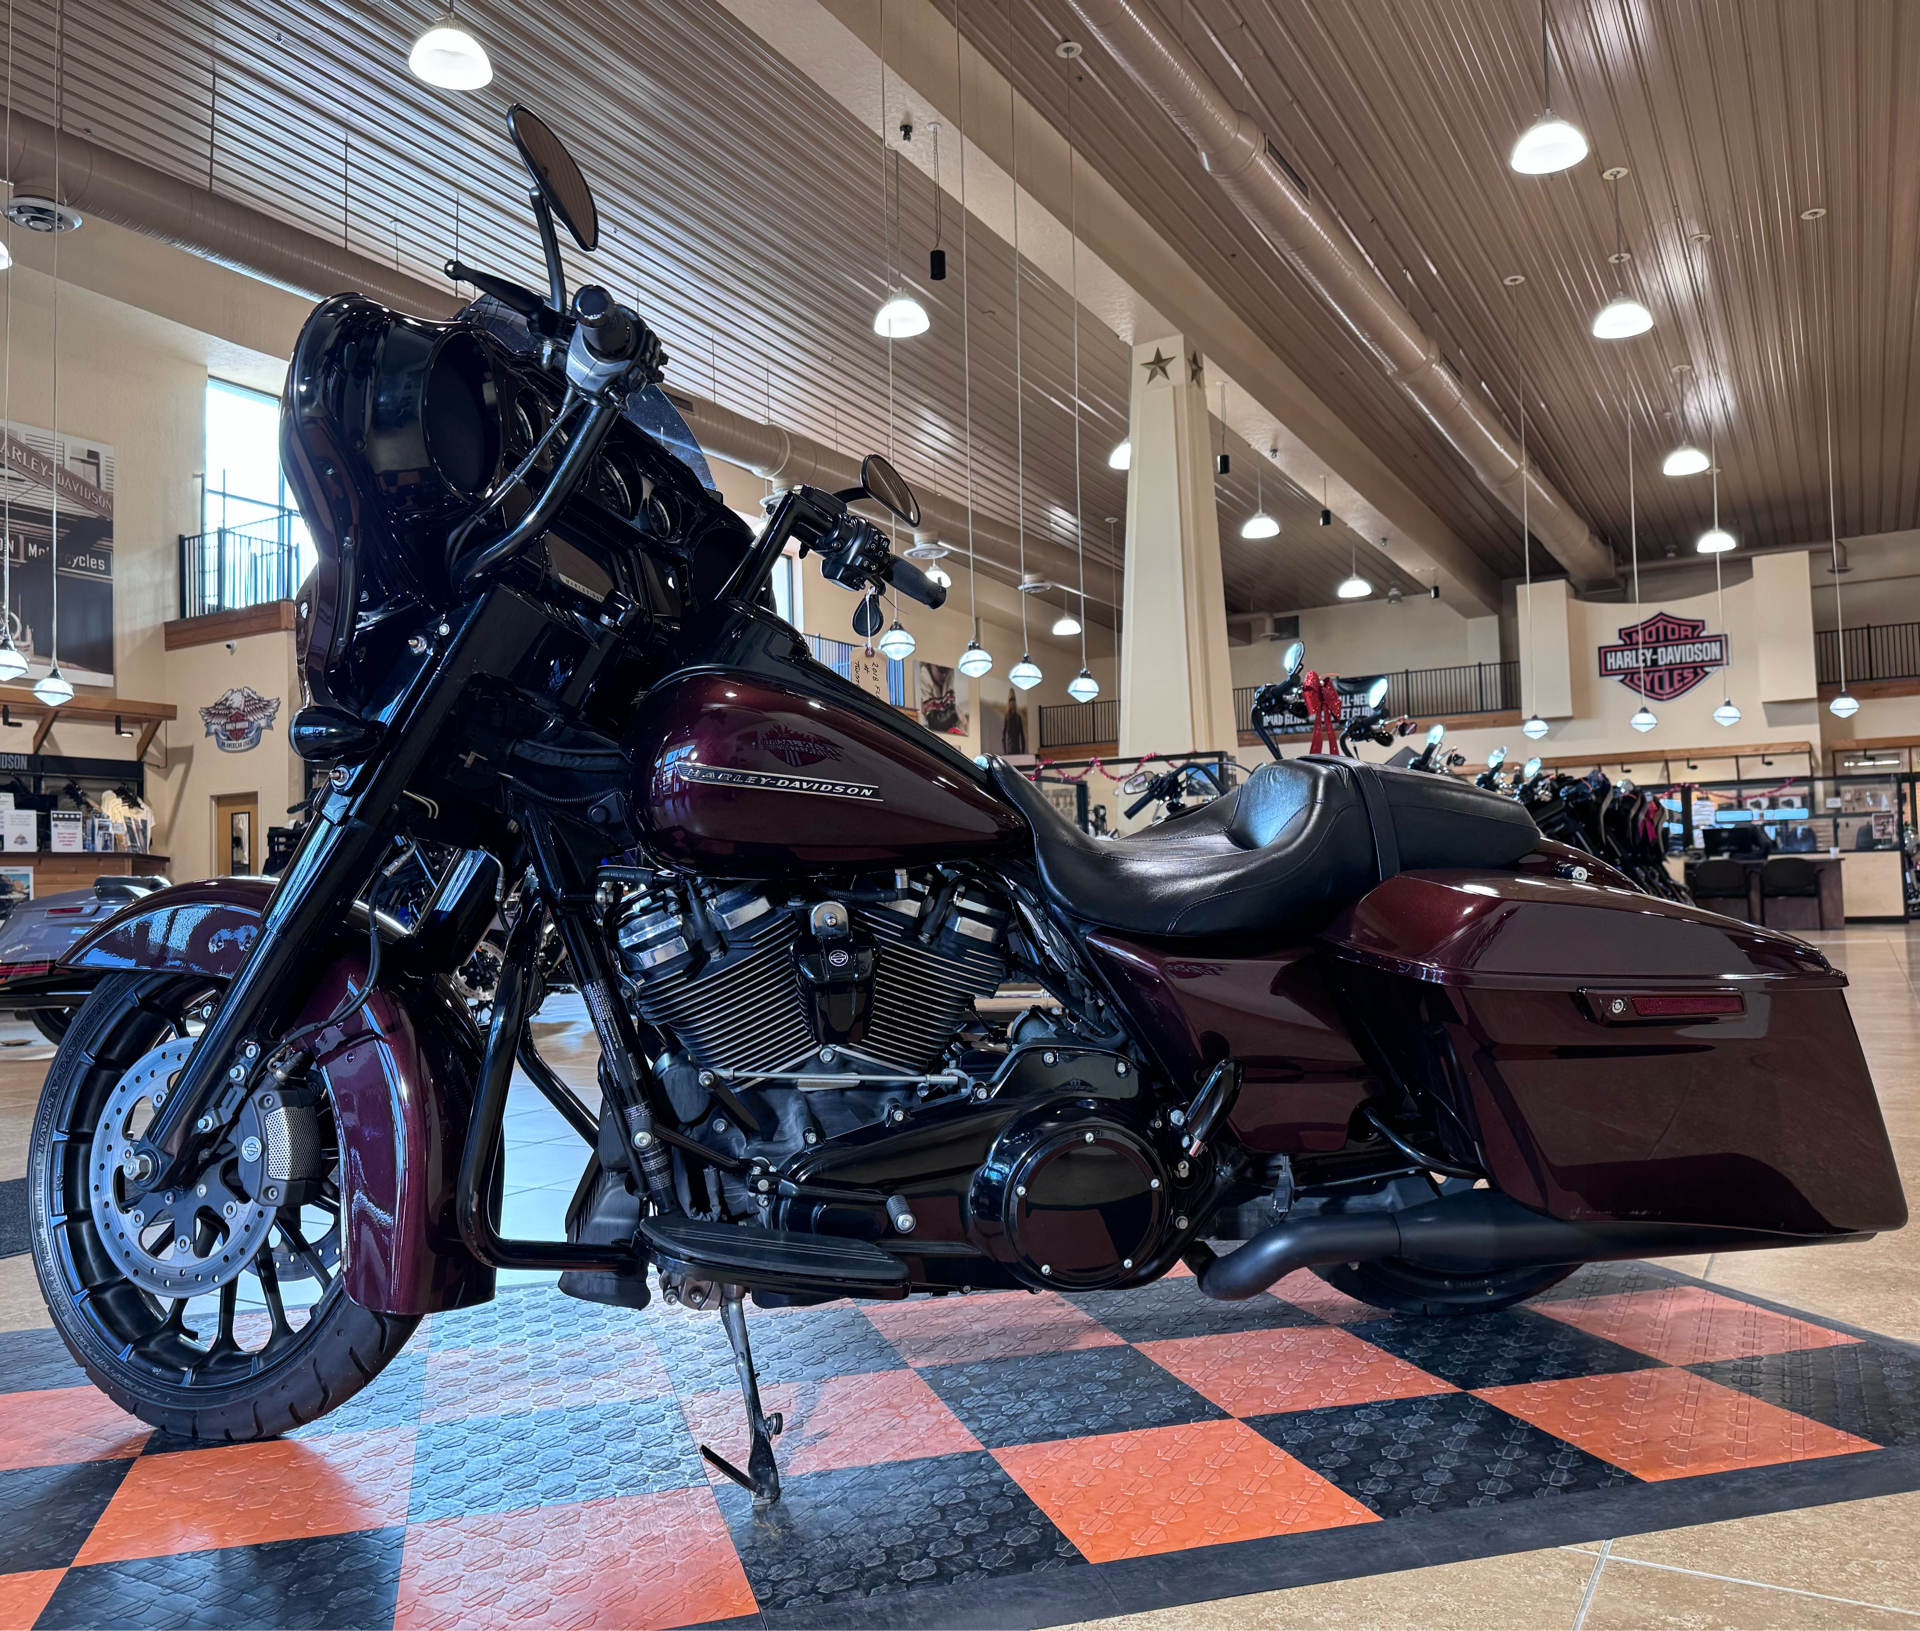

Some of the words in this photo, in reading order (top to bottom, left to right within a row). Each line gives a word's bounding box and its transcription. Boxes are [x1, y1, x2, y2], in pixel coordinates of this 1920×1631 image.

[1632, 621, 1693, 643] MOTOR
[1606, 641, 1721, 670] HARLEY-DAVIDSON
[871, 662, 879, 682] 2018
[1633, 668, 1695, 694] CYCLES
[687, 768, 874, 797] HARLEY-DAVIDSON
